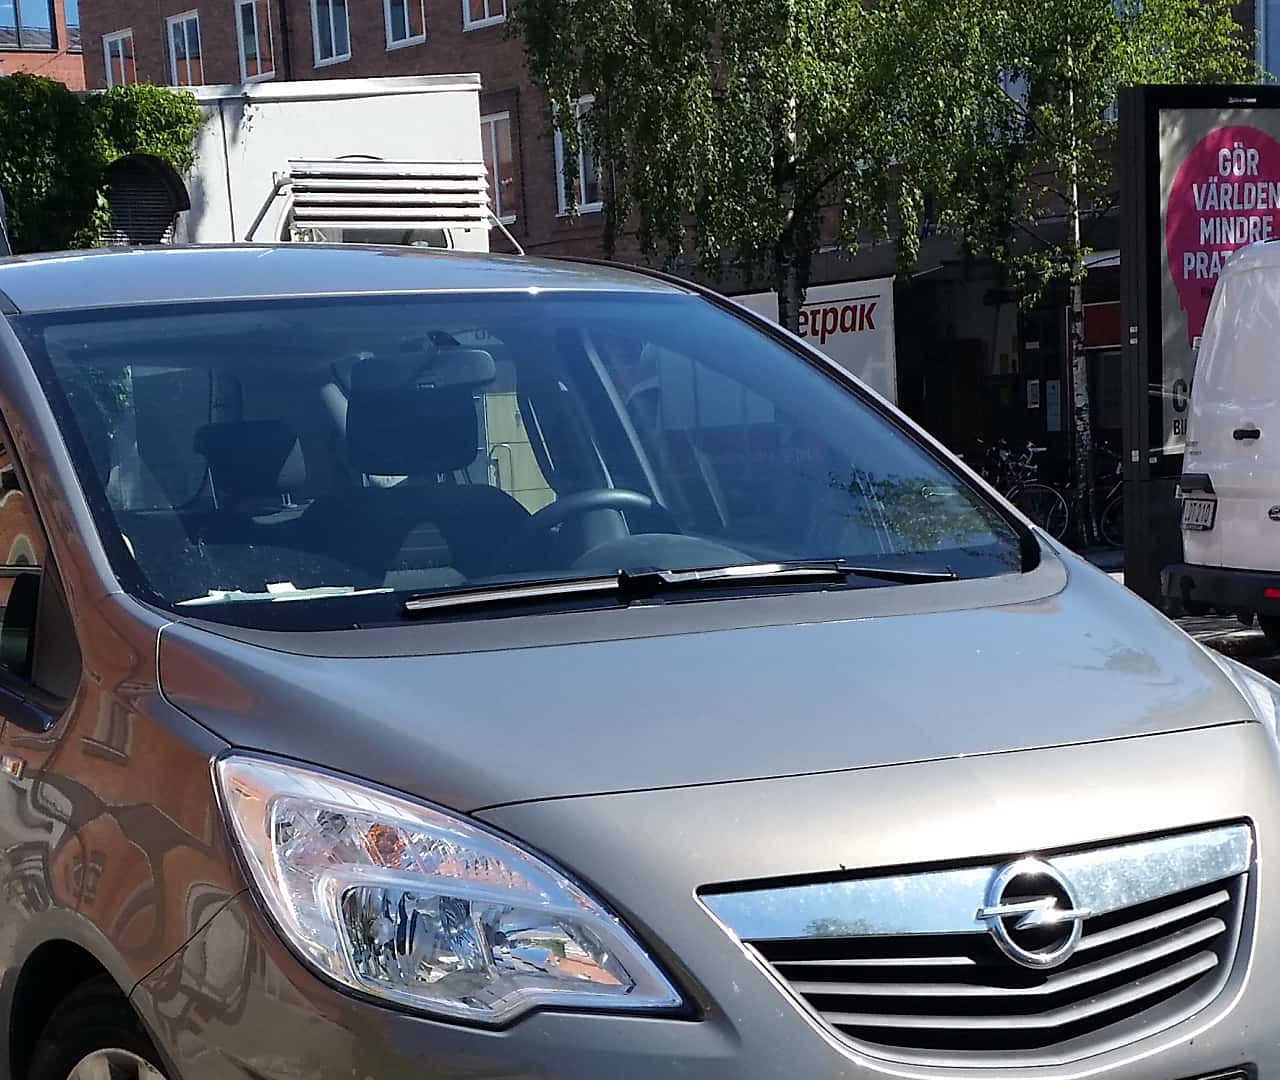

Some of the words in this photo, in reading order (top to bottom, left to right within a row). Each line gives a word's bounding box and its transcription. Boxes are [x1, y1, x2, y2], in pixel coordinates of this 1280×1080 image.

[1218, 142, 1260, 177] GÖR
[1200, 215, 1273, 245] MINDRE
[799, 302, 877, 345] etpak
